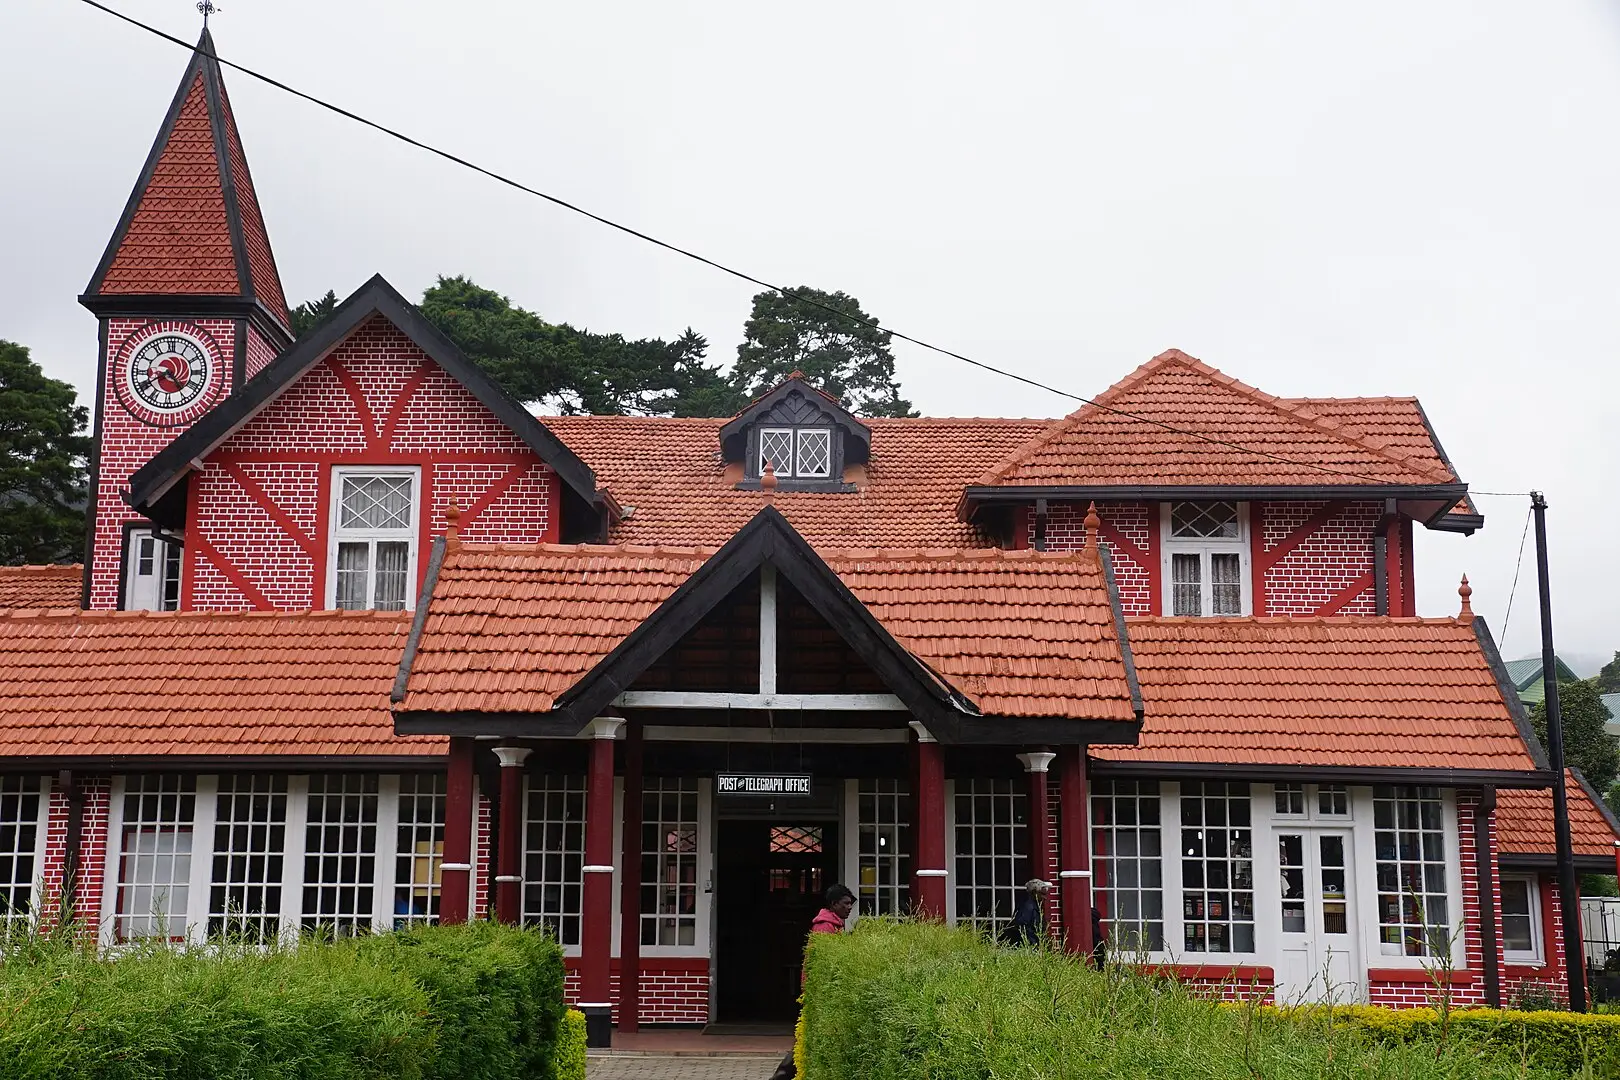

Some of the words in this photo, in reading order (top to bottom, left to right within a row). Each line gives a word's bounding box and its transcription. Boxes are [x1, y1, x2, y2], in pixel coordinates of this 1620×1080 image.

[719, 777, 738, 790] POST
[745, 777, 783, 791] TELEGRAPH
[785, 778, 809, 791] OFFICE
